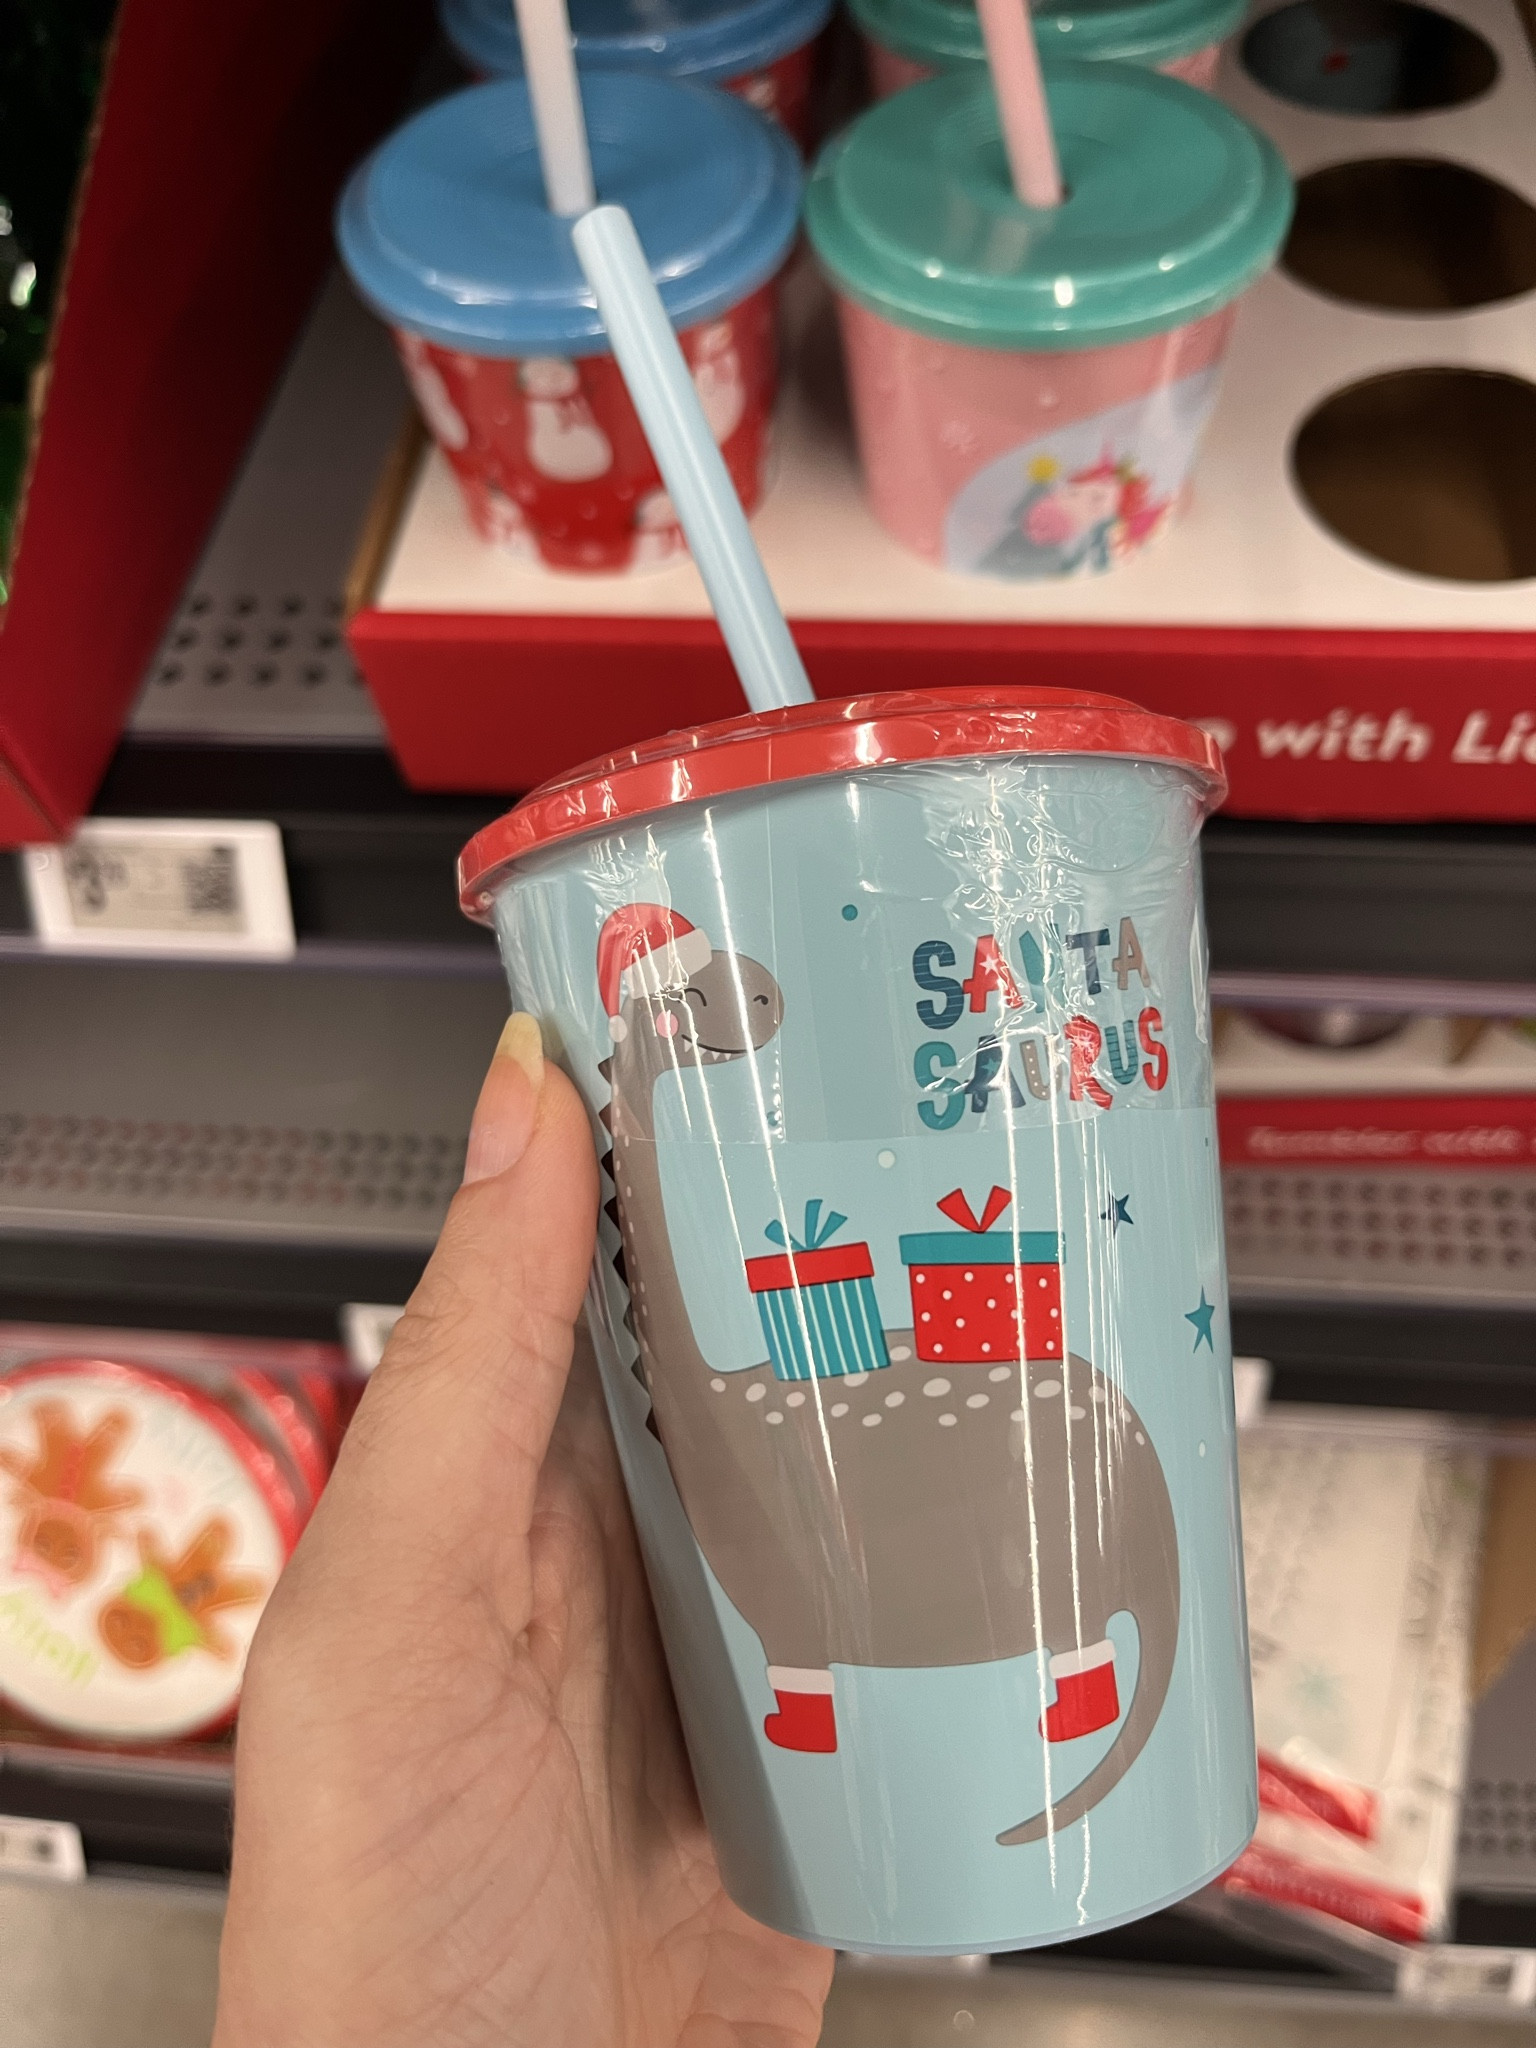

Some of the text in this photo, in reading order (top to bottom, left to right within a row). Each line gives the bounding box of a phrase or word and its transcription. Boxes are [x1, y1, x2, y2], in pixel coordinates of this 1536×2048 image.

[1256, 708, 1431, 762] with
[912, 916, 1152, 1030] SANTA
[913, 1006, 1169, 1131] SAURUS
